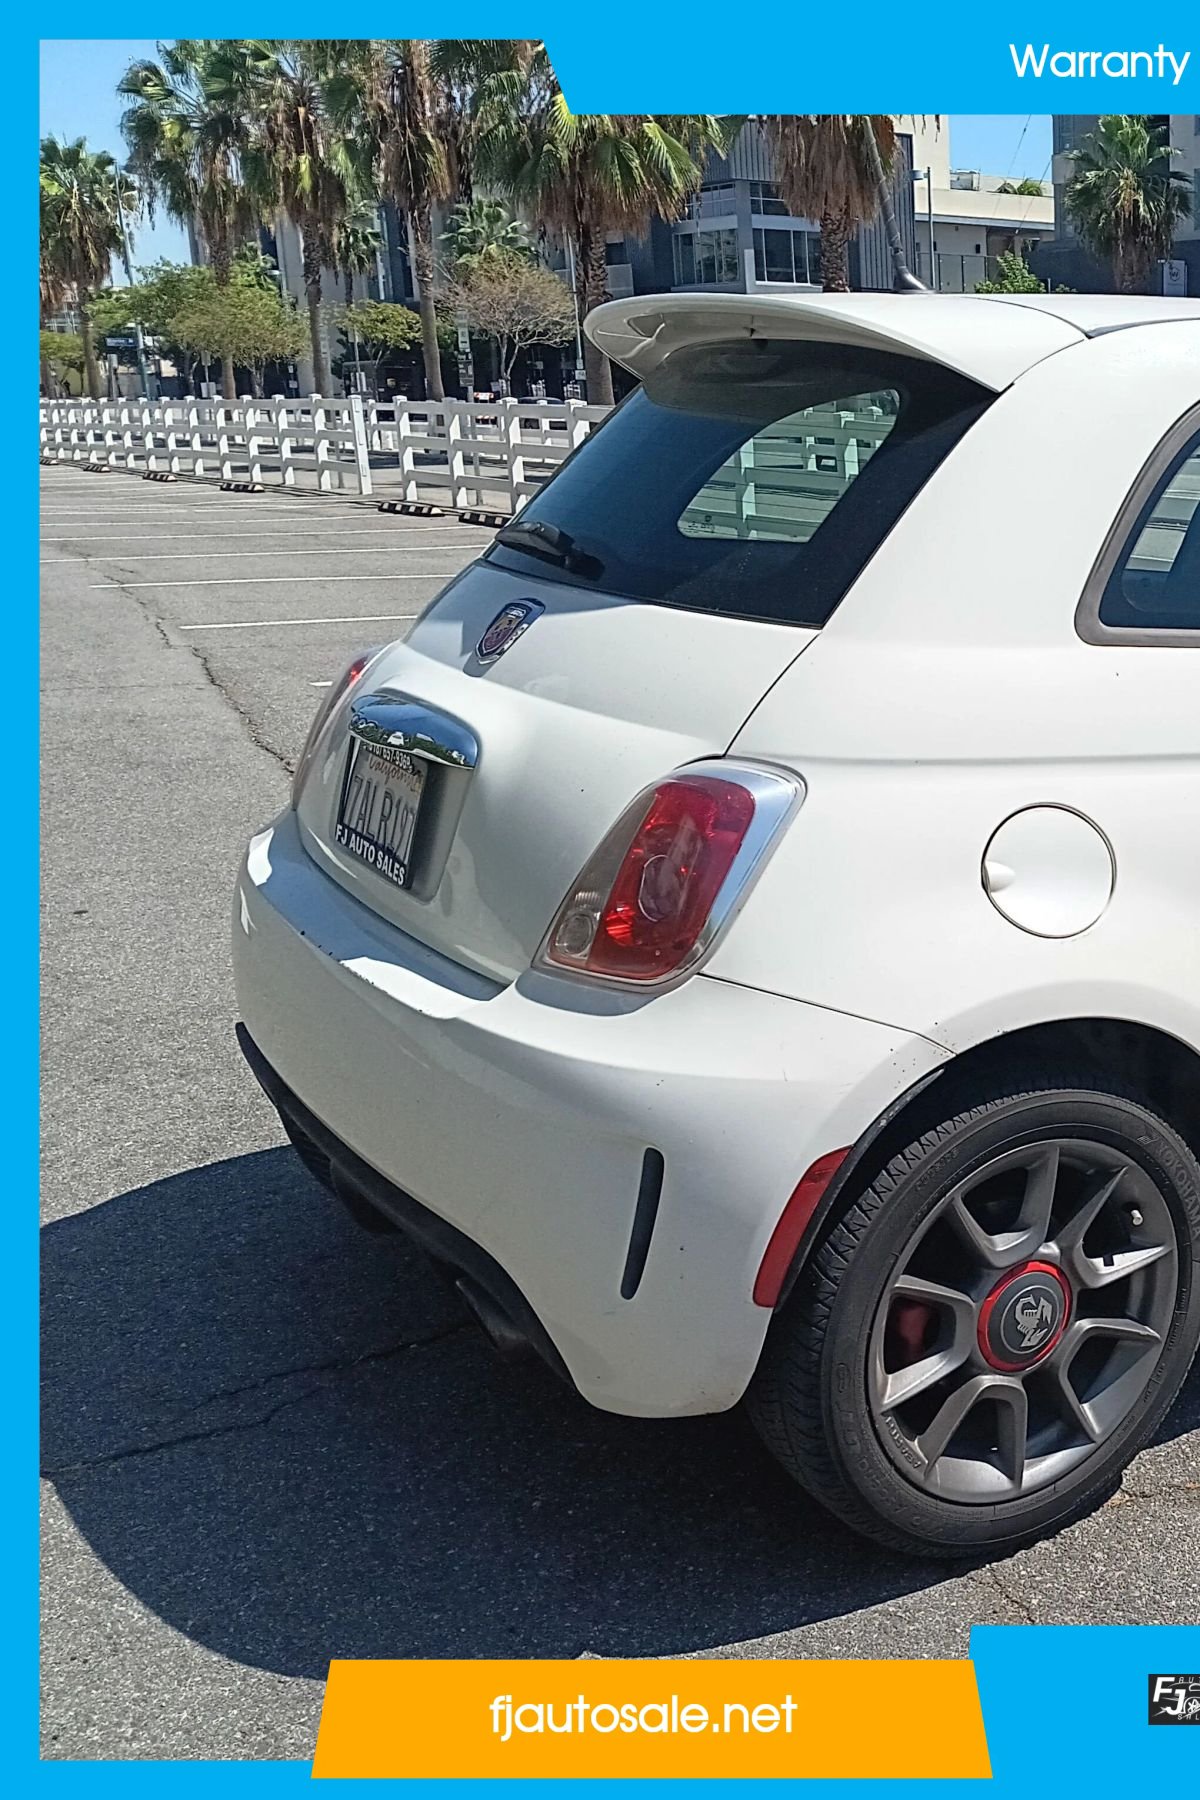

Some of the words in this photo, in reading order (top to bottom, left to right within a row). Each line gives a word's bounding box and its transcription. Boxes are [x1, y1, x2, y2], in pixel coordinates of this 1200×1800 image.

[335, 824, 348, 845] FJ
[349, 833, 376, 863] AUTO
[376, 850, 405, 886] SALES
[345, 775, 415, 864] 7ALR197
